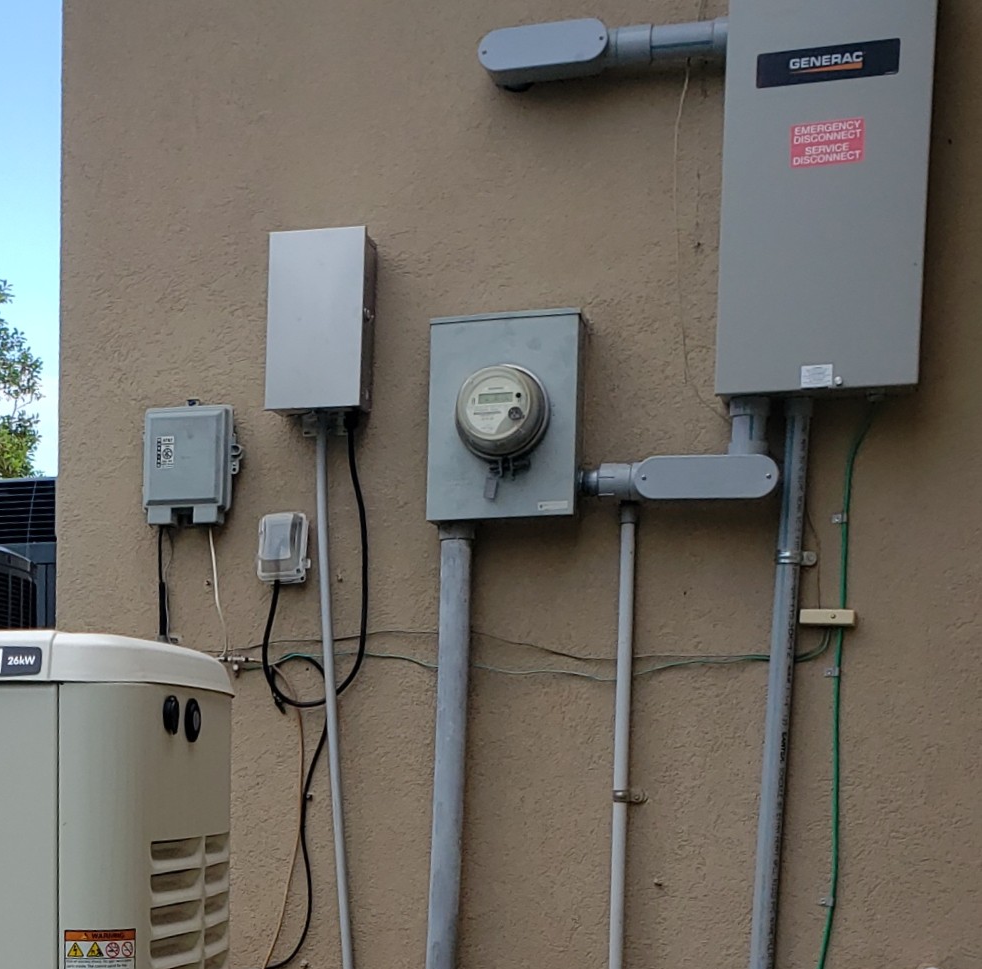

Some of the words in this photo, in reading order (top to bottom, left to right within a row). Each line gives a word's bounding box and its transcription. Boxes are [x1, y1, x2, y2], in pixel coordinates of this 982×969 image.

[789, 51, 863, 69] GENERAC
[794, 120, 861, 135] EMERGENCY
[793, 129, 862, 145] DISCONNECT
[805, 142, 849, 155] SERVICE
[793, 150, 861, 166] DISCONNECT
[7, 655, 36, 666] 26kW
